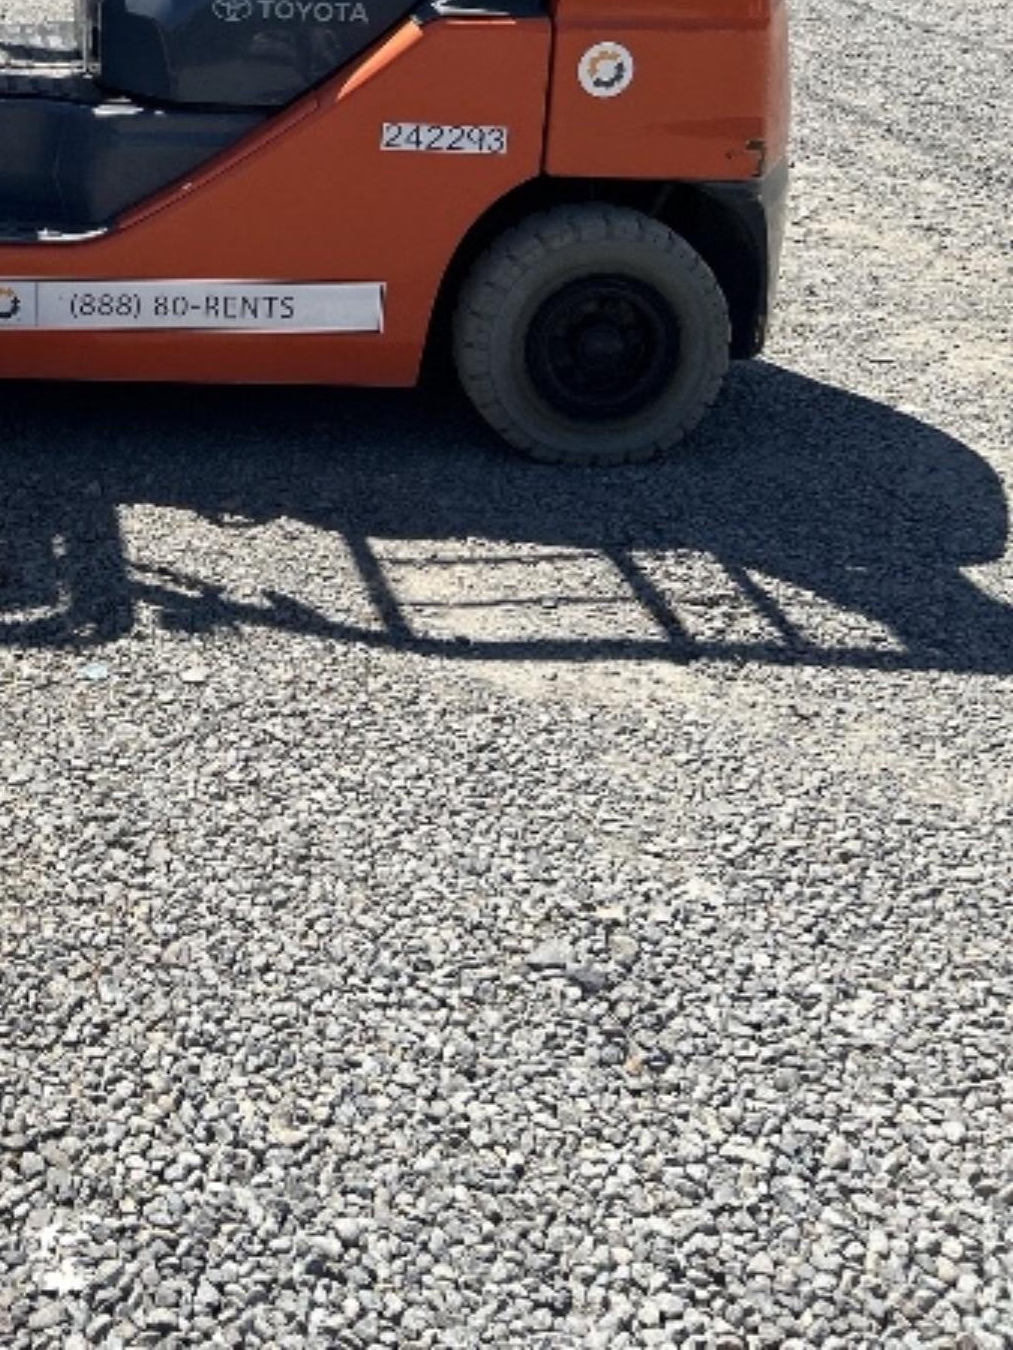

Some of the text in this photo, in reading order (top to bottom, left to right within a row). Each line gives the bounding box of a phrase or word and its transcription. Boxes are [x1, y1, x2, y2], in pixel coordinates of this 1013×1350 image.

[256, 0, 369, 24] TOYOTA
[384, 124, 504, 153] 242293
[69, 291, 295, 319] (888) 80-RENTS
